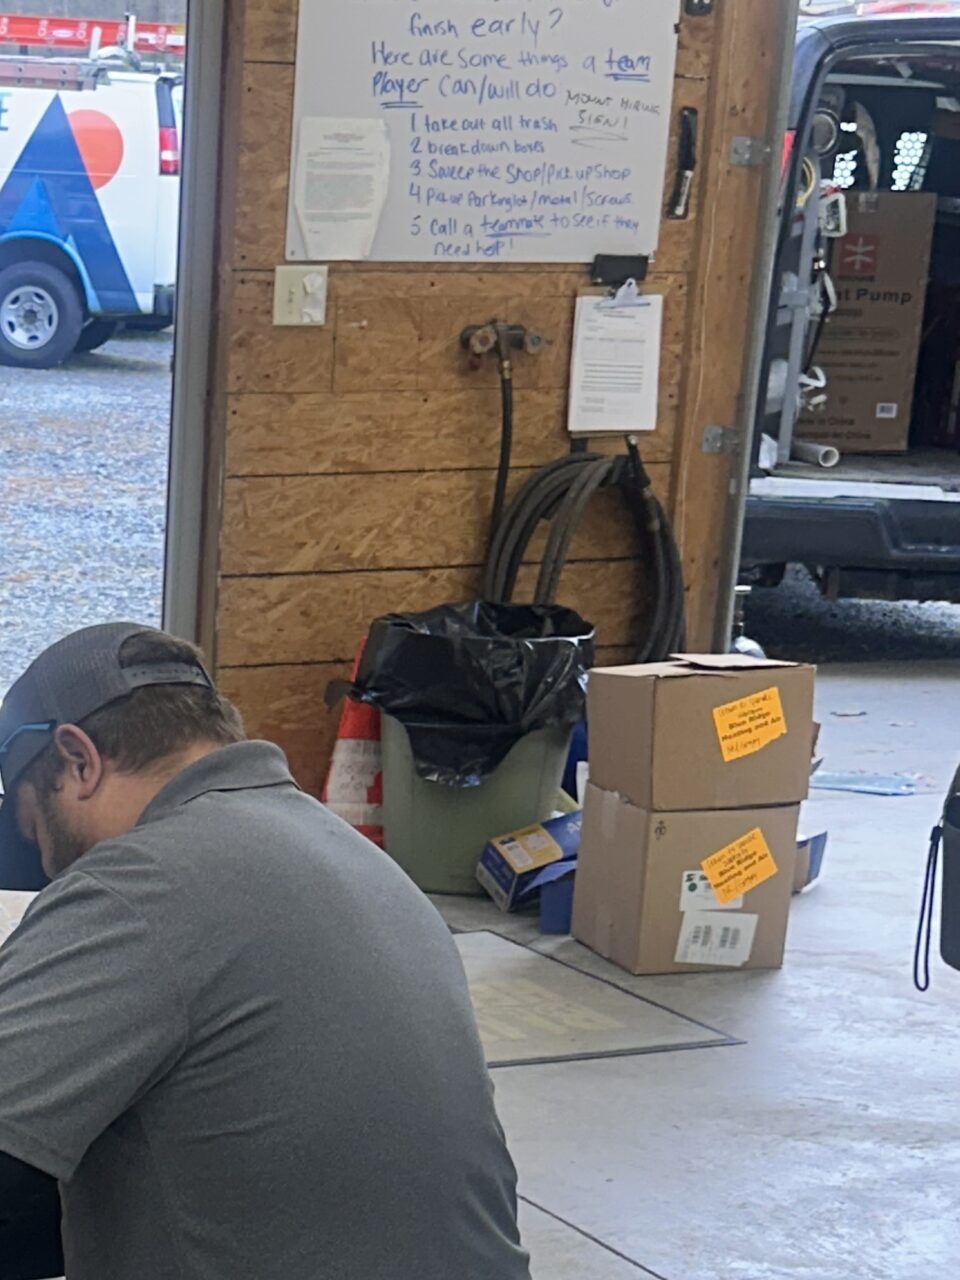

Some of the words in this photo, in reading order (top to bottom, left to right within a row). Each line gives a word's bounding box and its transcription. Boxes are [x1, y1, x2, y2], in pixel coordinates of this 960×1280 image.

[408, 12, 458, 37] finish
[371, 41, 413, 66] Here
[419, 50, 453, 66] are
[517, 52, 568, 73] things
[583, 54, 596, 73] a
[605, 48, 651, 72] team
[525, 79, 556, 98] do
[425, 116, 458, 132] take
[461, 117, 485, 131] out
[491, 115, 512, 130] all
[410, 137, 422, 154] 2
[471, 139, 510, 155] down
[410, 160, 422, 177] 3
[478, 163, 501, 179] the
[409, 183, 421, 199] 4
[410, 215, 421, 236] 5
[463, 223, 473, 237] a
[550, 213, 570, 229] to
[433, 240, 471, 257] need
[856, 287, 913, 305] Pump
